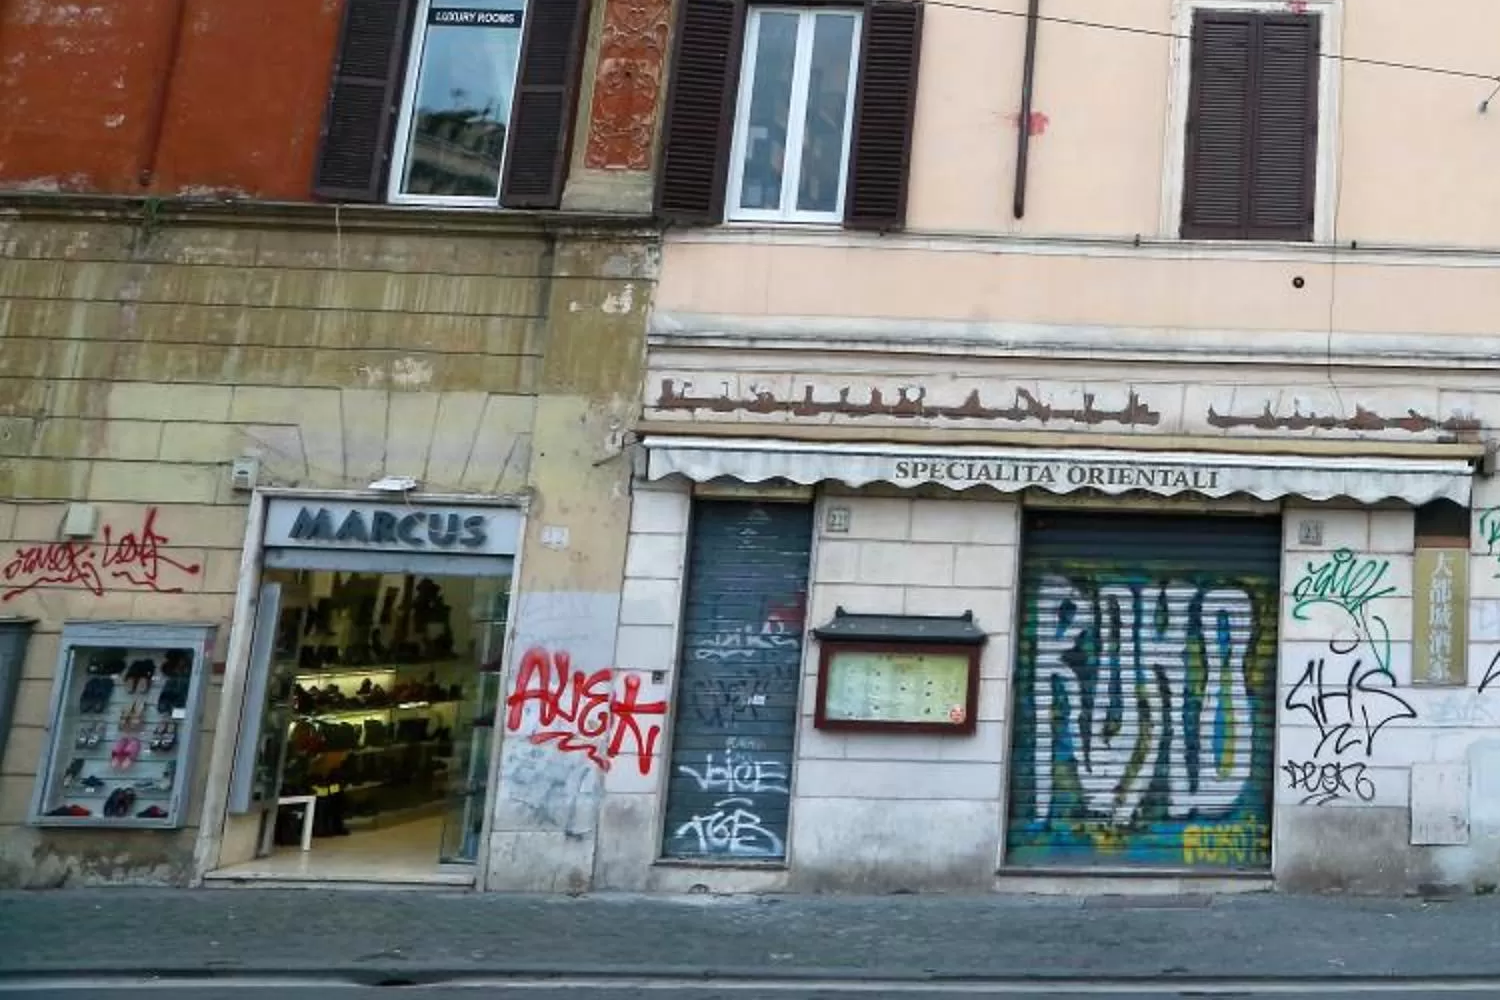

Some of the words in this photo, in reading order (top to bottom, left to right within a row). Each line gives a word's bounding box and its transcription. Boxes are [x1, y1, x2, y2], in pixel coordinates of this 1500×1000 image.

[435, 10, 476, 22] LUXURY
[477, 12, 516, 24] ROOMS
[1066, 464, 1218, 490] ORIENTALI
[287, 506, 488, 548] MARCUS
